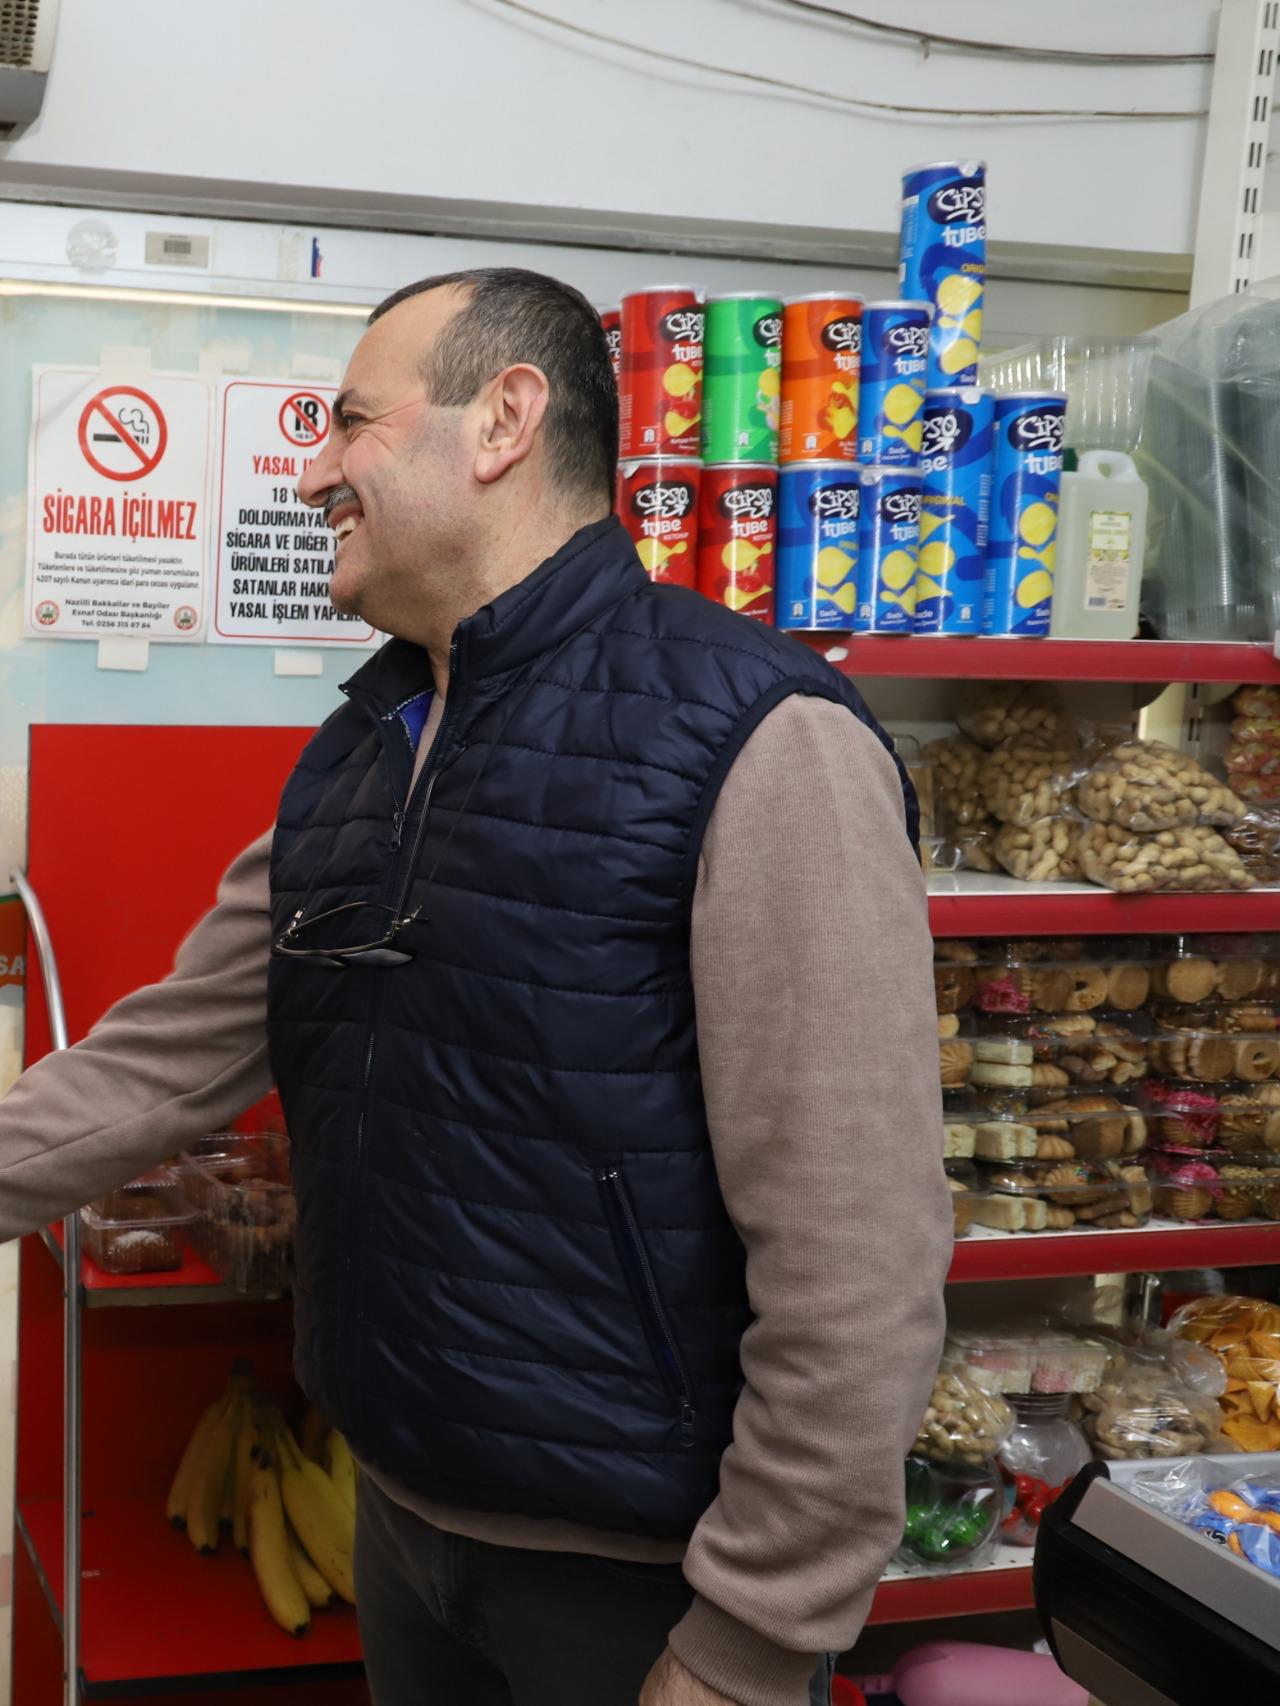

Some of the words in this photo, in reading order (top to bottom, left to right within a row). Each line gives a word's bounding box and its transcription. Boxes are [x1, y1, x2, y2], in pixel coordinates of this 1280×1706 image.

[936, 187, 984, 211] CIPS
[666, 312, 704, 332] CIPS
[759, 318, 782, 337] CIP
[828, 322, 861, 340] CIPS
[889, 327, 929, 346] CIPS
[1018, 415, 1063, 438] CIPS
[253, 455, 298, 476] YASAL
[272, 487, 288, 503] 18
[886, 494, 920, 513] CIPS
[42, 488, 116, 537] SİGARA
[122, 491, 197, 543] İÇİLMEZ
[227, 528, 271, 550] SİGARA
[275, 534, 290, 550] VE
[294, 530, 328, 551] DİĞER
[231, 551, 290, 573] ÜRÜNLERİ
[293, 559, 334, 575] SATILA
[233, 579, 297, 597] SATANLAR
[301, 582, 329, 597] HAKK
[230, 602, 267, 619] YASAL
[272, 600, 309, 624] İŞLEM
